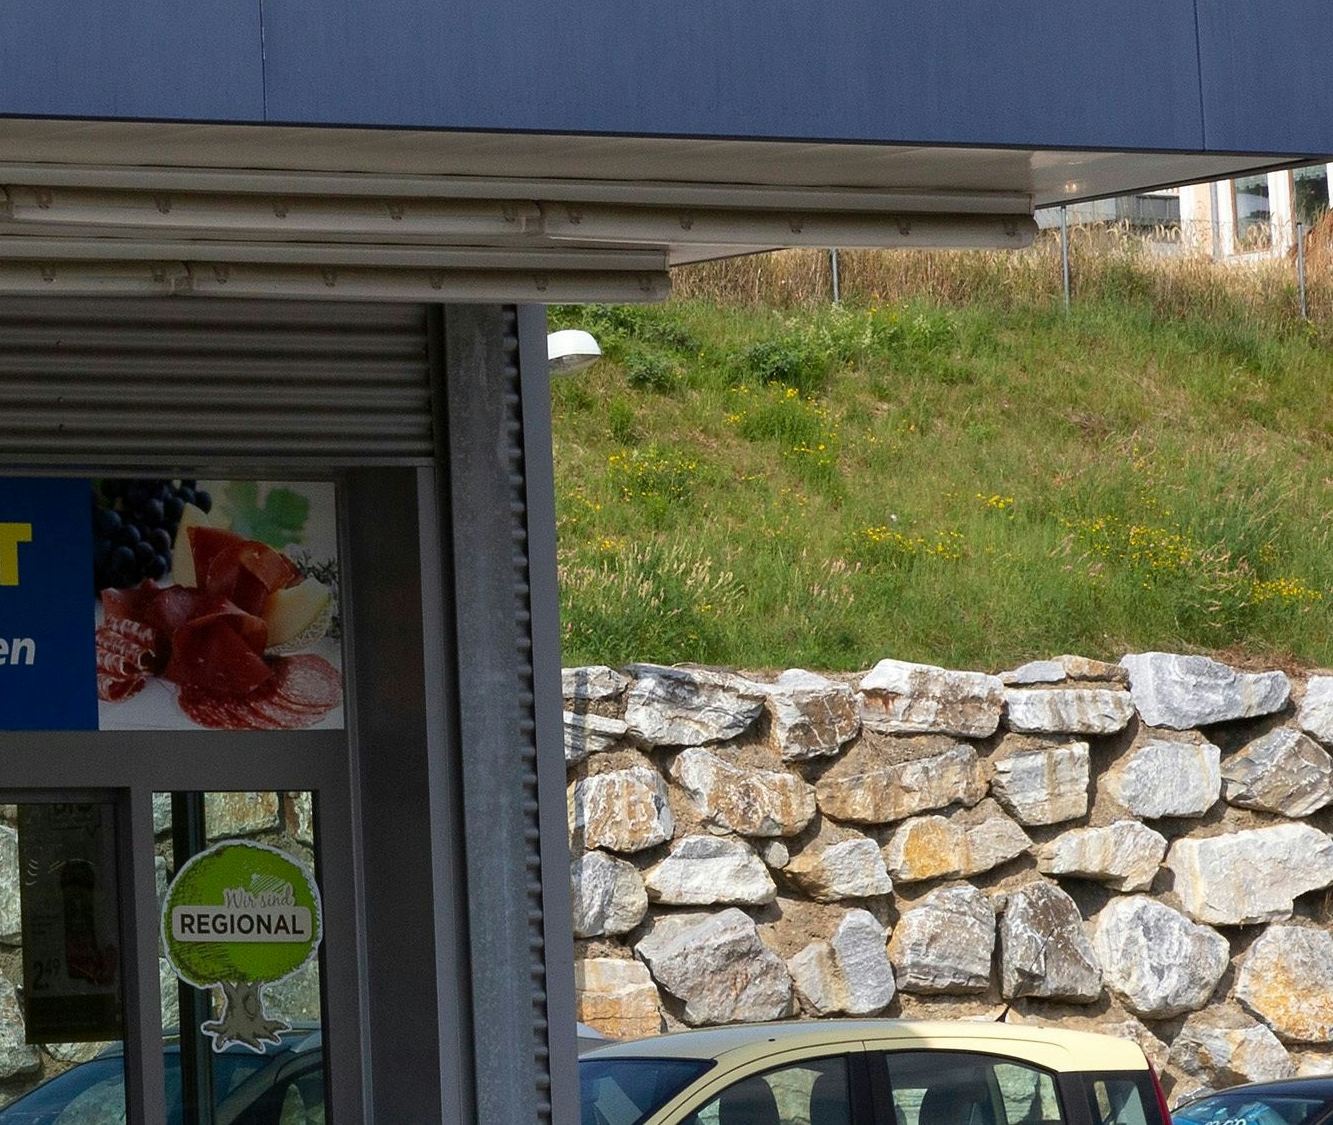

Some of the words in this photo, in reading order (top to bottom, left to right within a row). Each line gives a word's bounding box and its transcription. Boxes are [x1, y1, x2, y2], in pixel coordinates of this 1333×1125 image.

[226, 889, 254, 909] Wir
[260, 884, 292, 908] sind
[180, 913, 305, 935] REGIONAL
